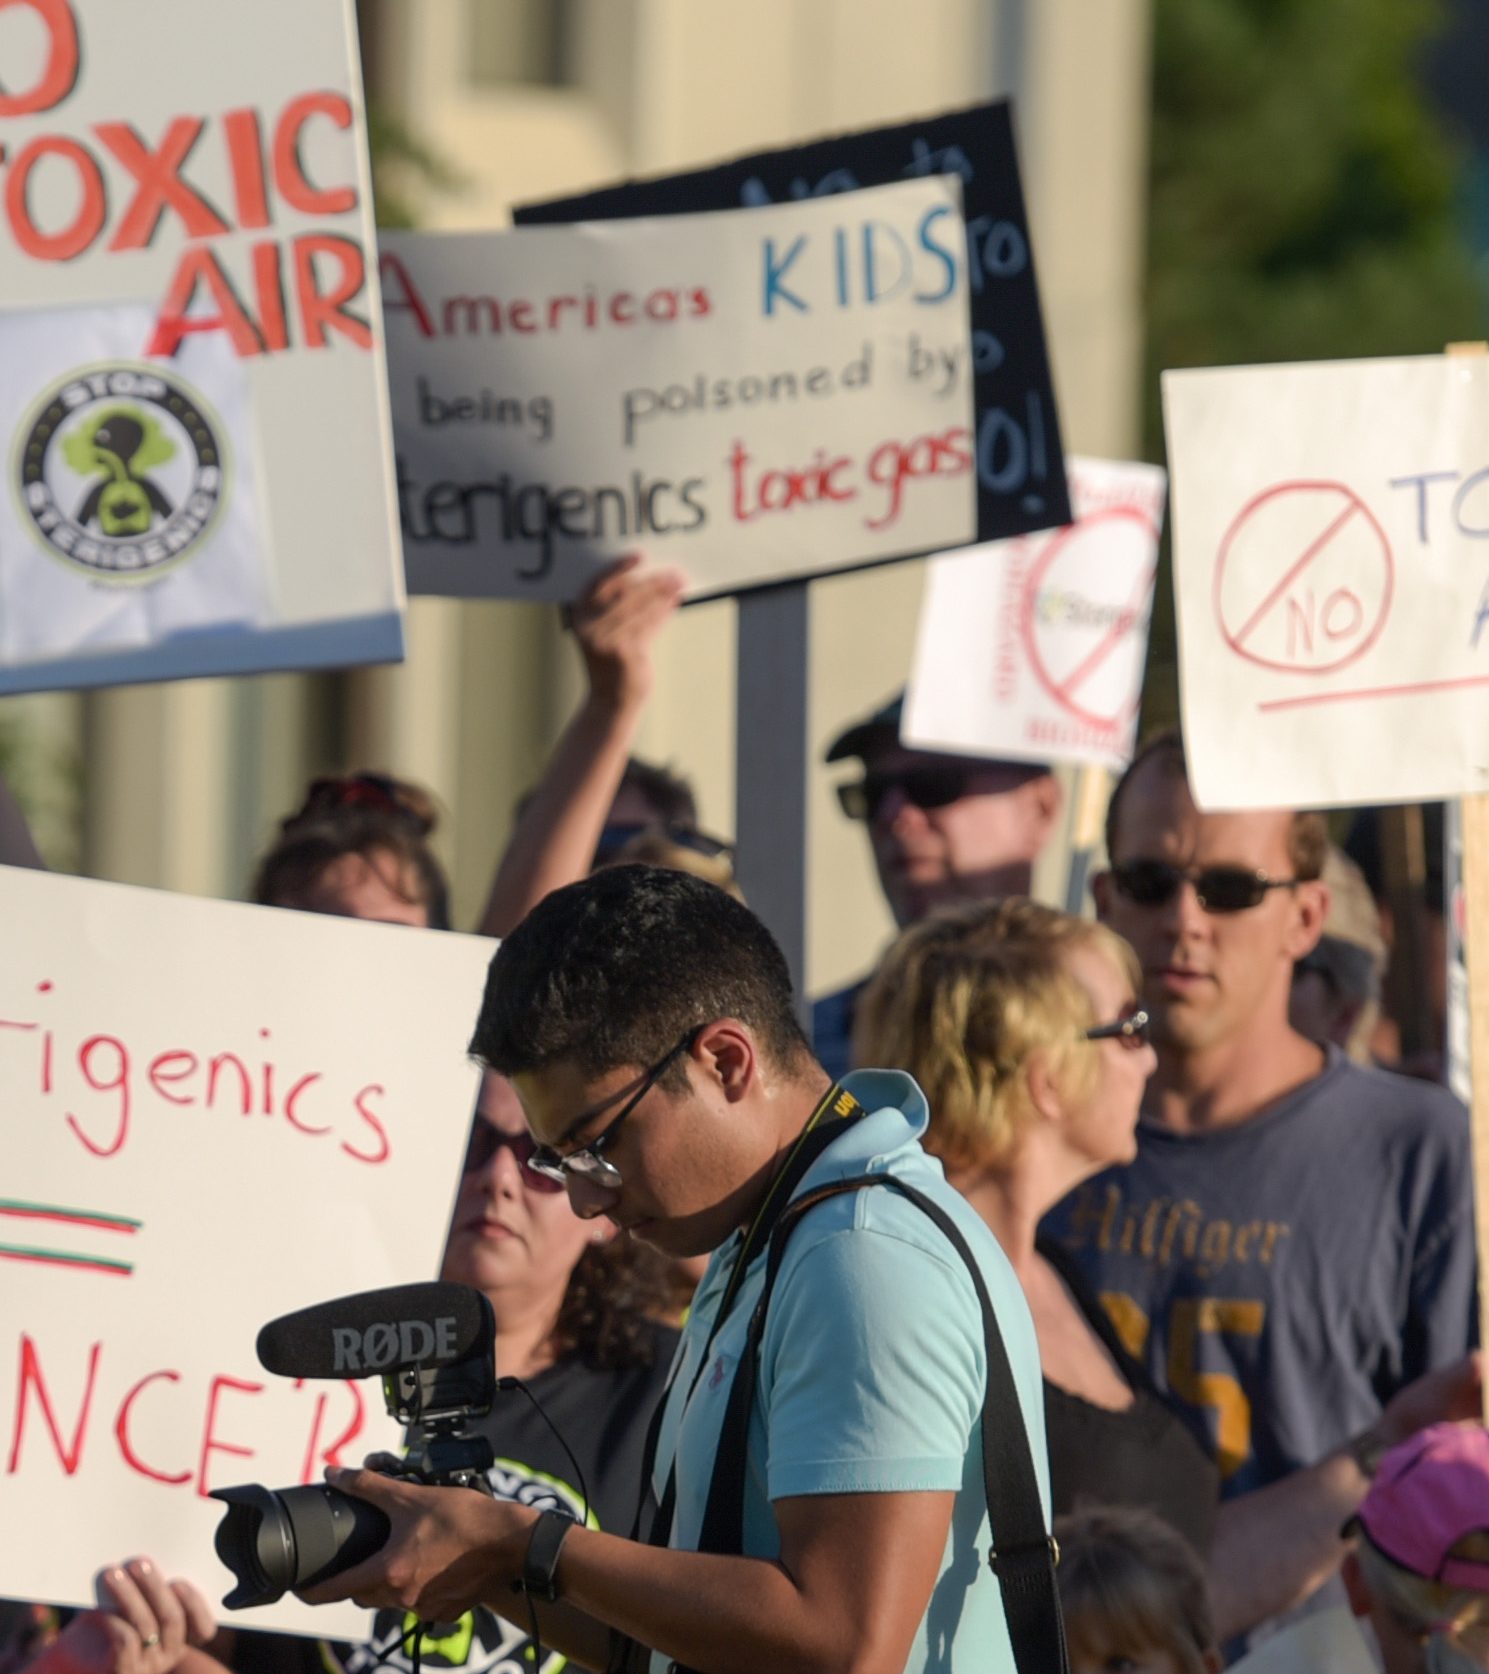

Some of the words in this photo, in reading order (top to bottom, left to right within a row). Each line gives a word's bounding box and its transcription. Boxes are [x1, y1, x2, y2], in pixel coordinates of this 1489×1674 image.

[143, 233, 377, 361] AIR
[761, 204, 958, 318] KIDS
[60, 371, 167, 406] STOP
[416, 375, 554, 443] being
[622, 343, 873, 444] poisoned
[908, 332, 966, 398] by
[24, 465, 220, 572] STERIGENICS
[727, 438, 858, 522] toxic
[866, 426, 973, 531] gas
[1285, 586, 1364, 660] NO
[1068, 1184, 1290, 1276] Hilfiger
[331, 1316, 457, 1371] RØDE
